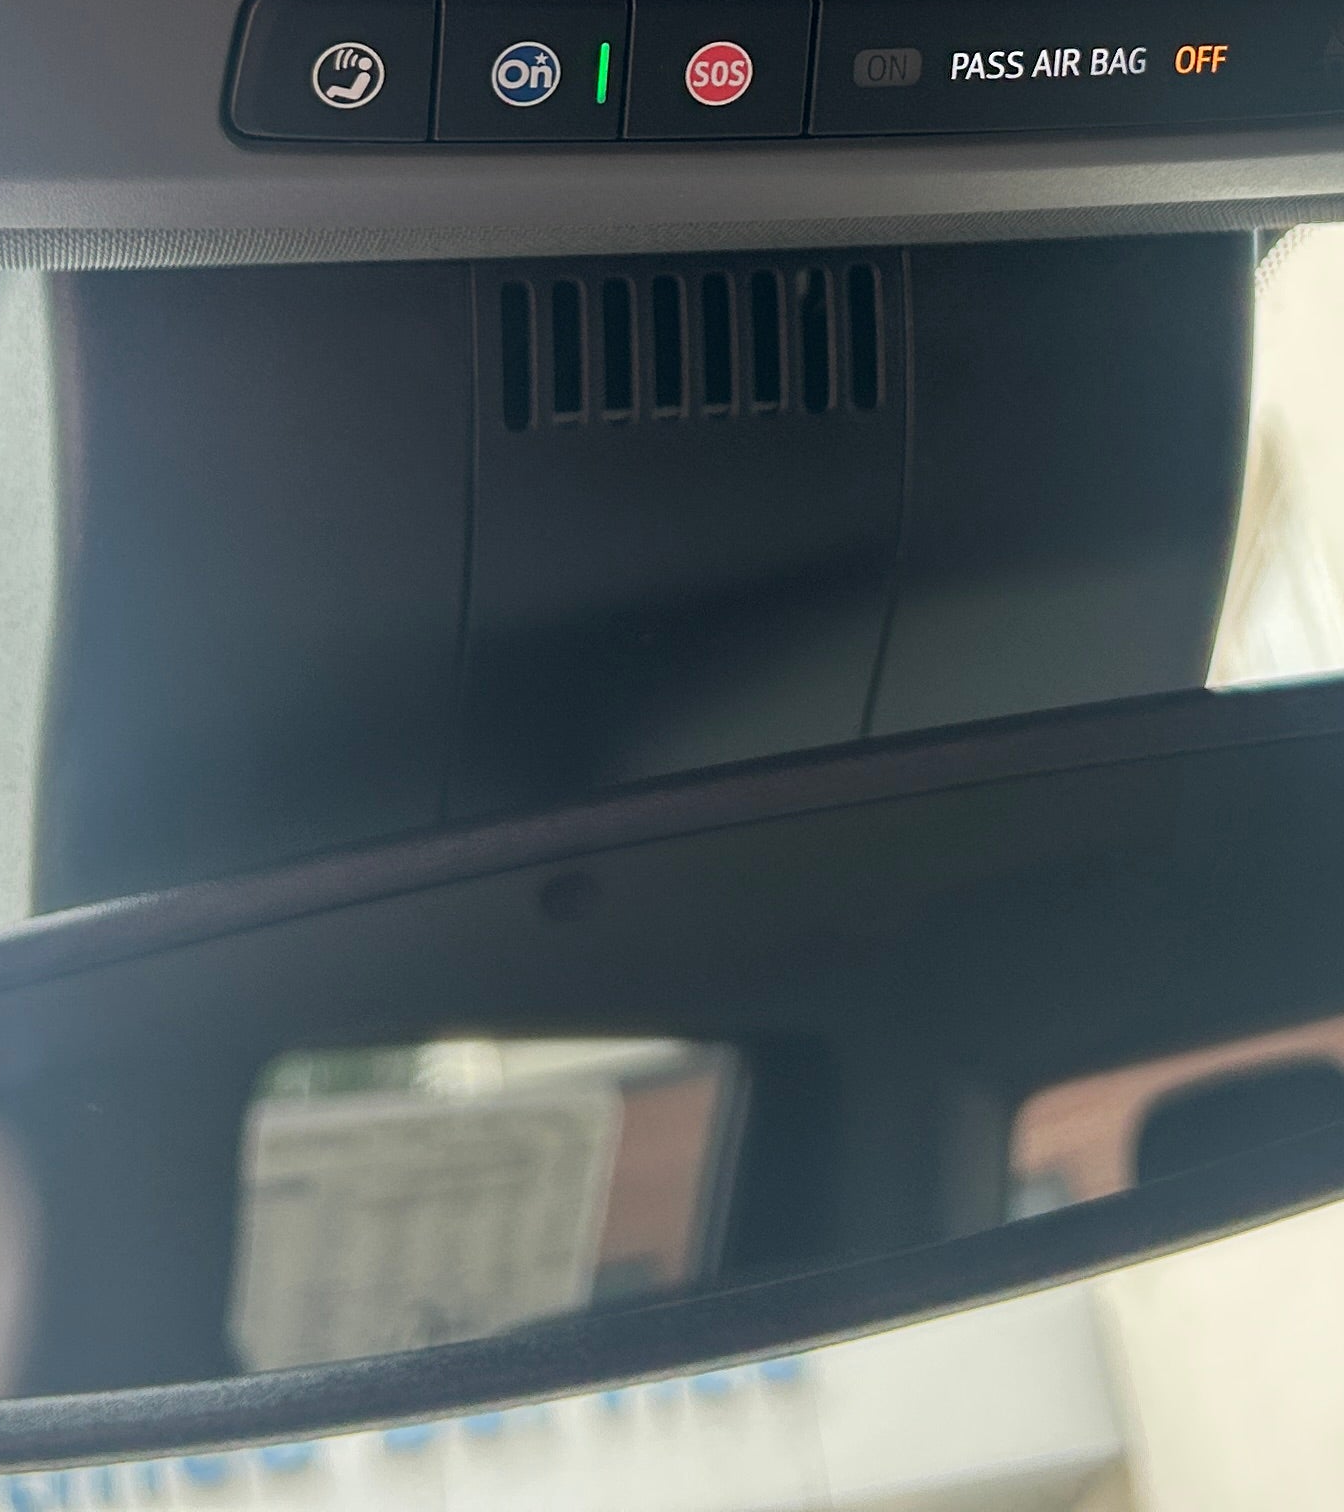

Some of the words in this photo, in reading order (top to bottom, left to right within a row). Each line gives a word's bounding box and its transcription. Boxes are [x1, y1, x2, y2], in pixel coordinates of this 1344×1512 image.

[497, 59, 554, 90] On
[692, 58, 746, 89] SOS
[866, 54, 907, 83] ON
[950, 50, 1025, 81] PASS
[1031, 48, 1081, 79] AIR
[1089, 46, 1148, 76] BAG
[1173, 44, 1229, 75] OFF
